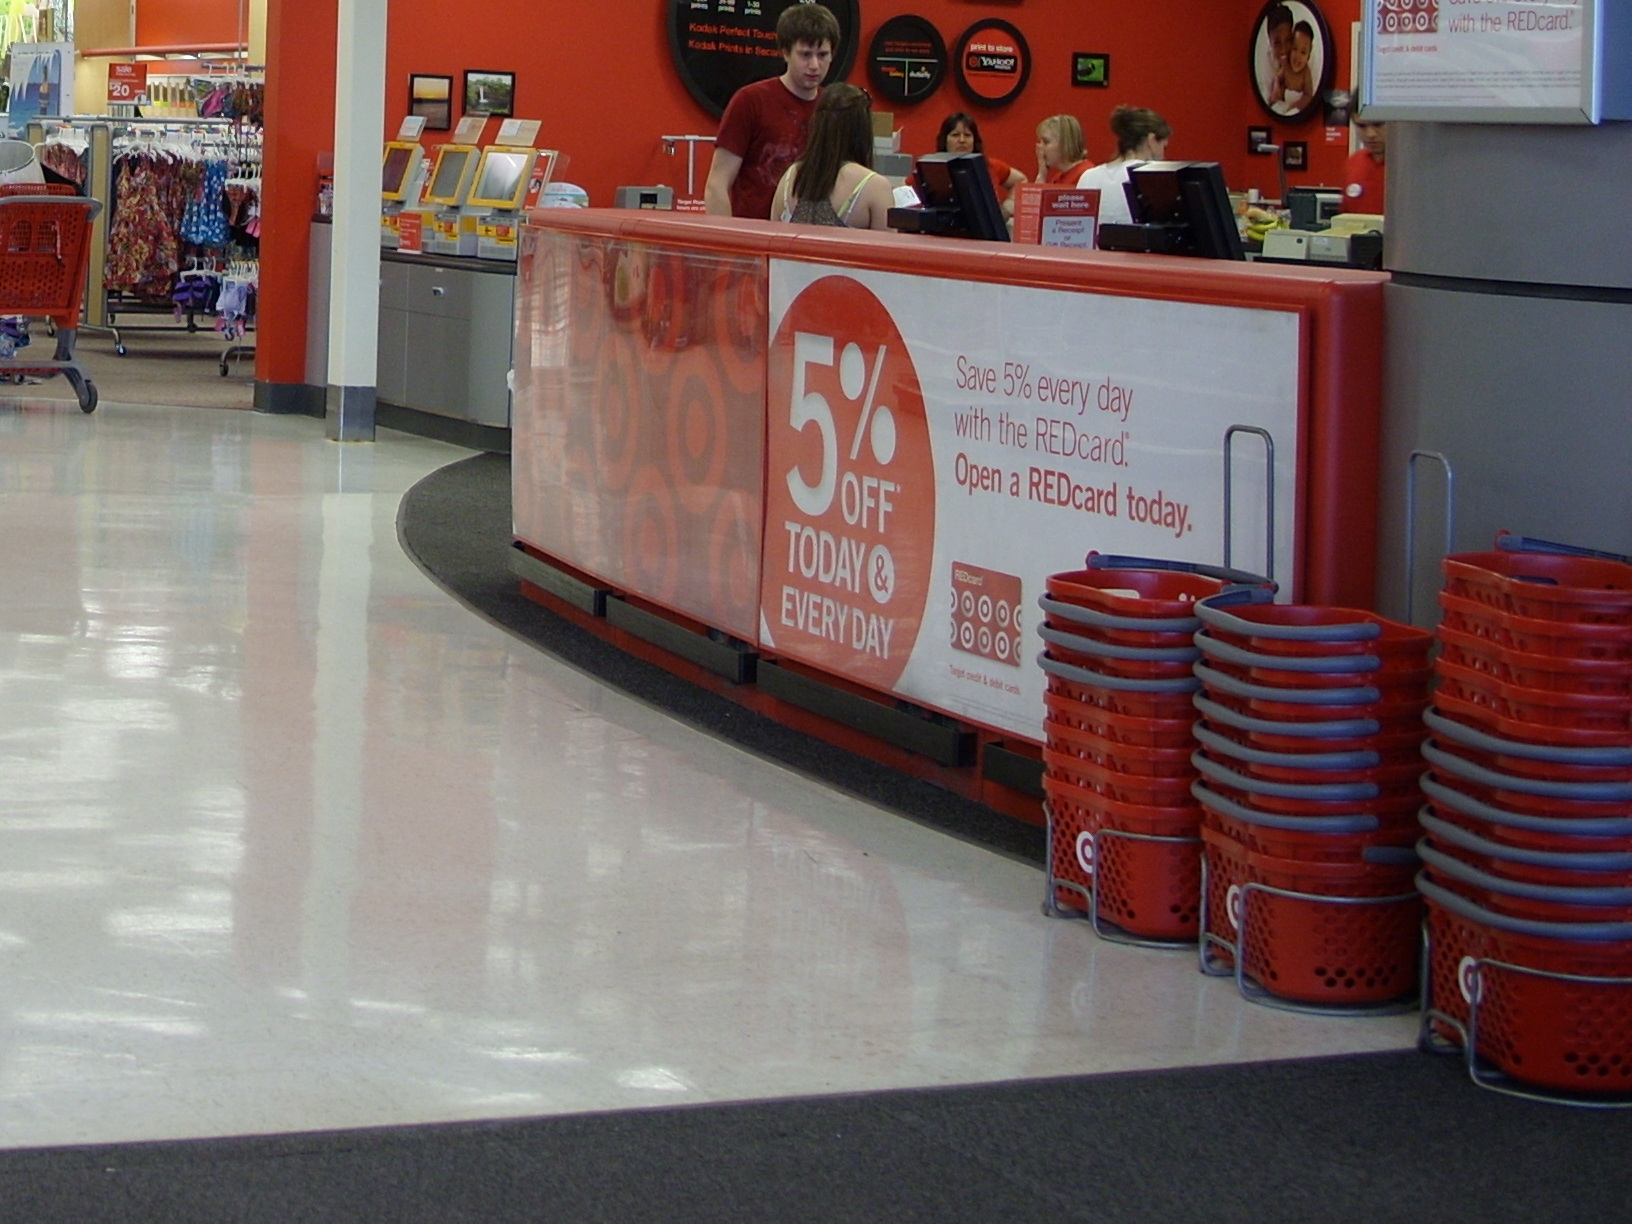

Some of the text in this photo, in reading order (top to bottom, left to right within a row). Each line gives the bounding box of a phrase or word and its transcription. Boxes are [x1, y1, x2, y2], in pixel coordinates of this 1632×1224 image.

[688, 40, 717, 51] Kodak
[689, 22, 718, 35] Kodak
[1448, 12, 1475, 33] with
[1480, 12, 1502, 33] the
[956, 355, 1133, 422] Save 5% every day
[786, 331, 896, 516] 5%
[954, 406, 991, 442] with
[998, 412, 1028, 448] the
[955, 452, 1192, 538] Open a REDcard today.
[784, 520, 866, 594] TODAY
[781, 585, 894, 660] EVERY DAY
